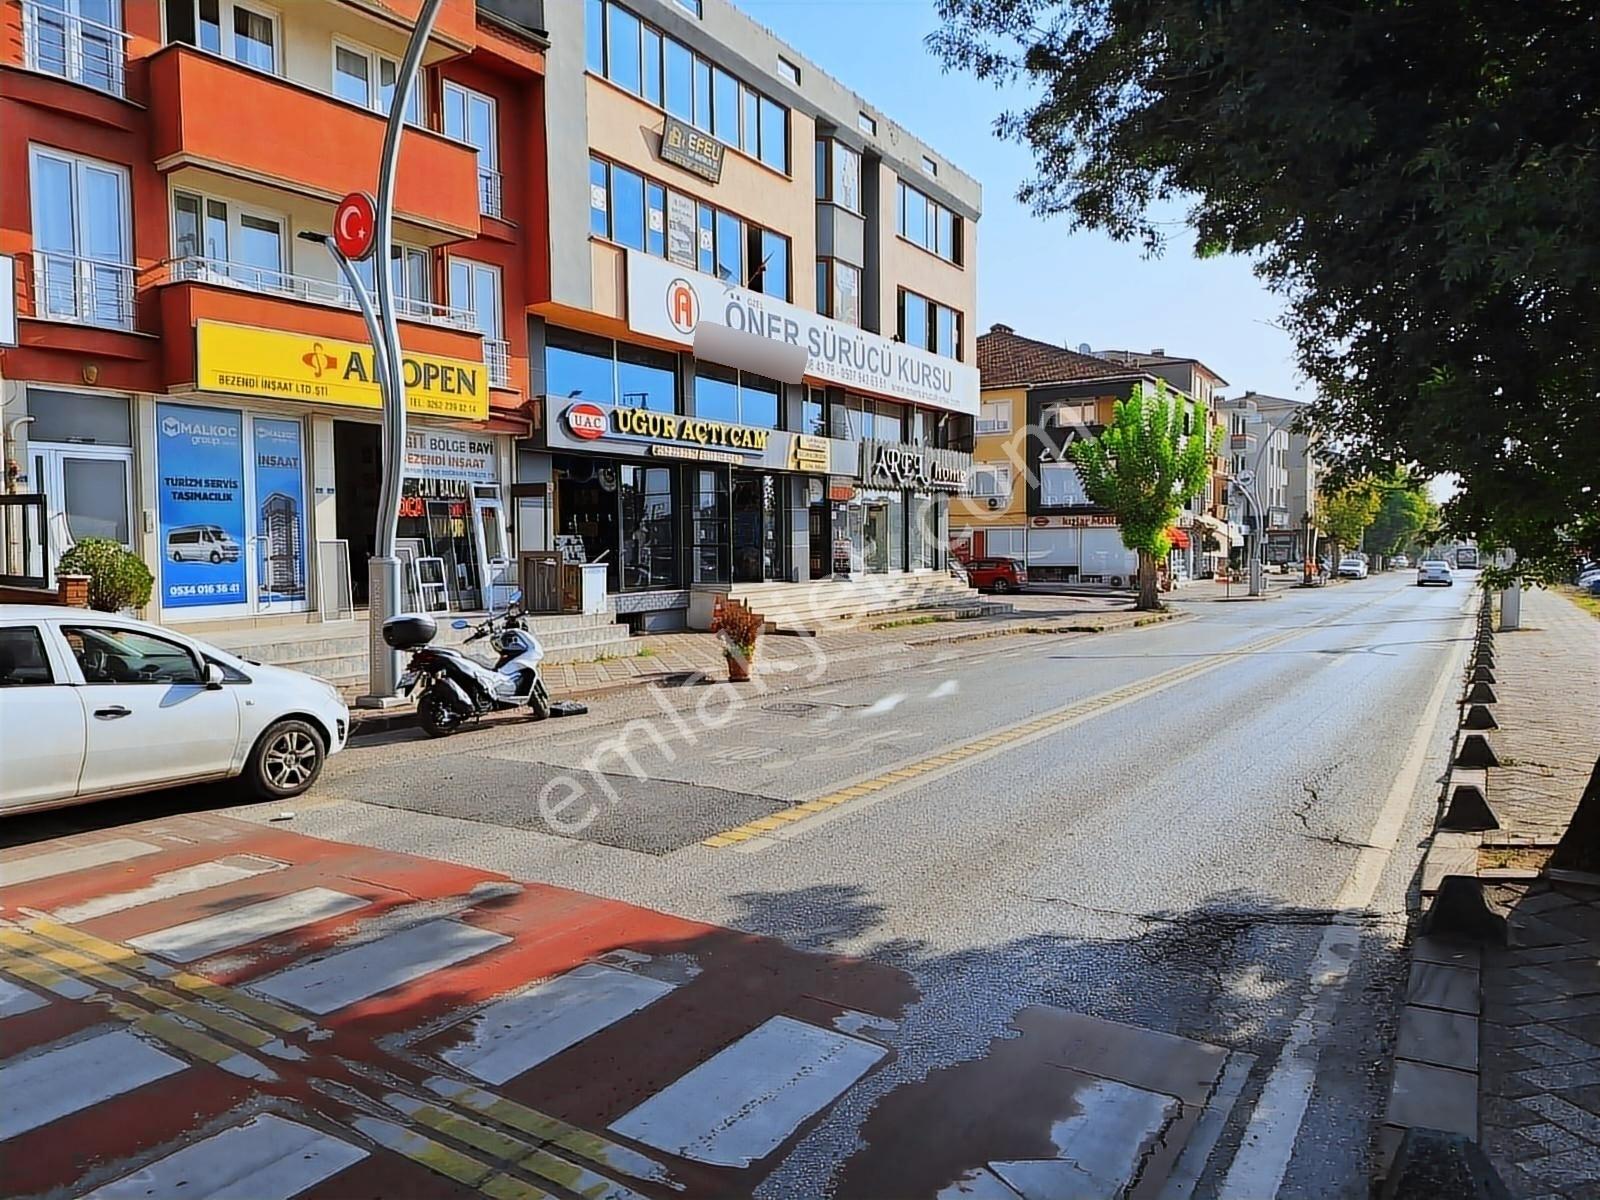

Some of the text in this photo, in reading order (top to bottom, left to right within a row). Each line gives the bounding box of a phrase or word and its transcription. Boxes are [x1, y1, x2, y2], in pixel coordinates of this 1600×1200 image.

[807, 325, 892, 377] SÜRÜCÜ
[898, 354, 953, 393] KURSU
[574, 414, 602, 428] UAC
[617, 409, 677, 438] UĞUR
[680, 419, 727, 445] AÇTI
[934, 461, 967, 481] home
[204, 477, 239, 489] SERVİS
